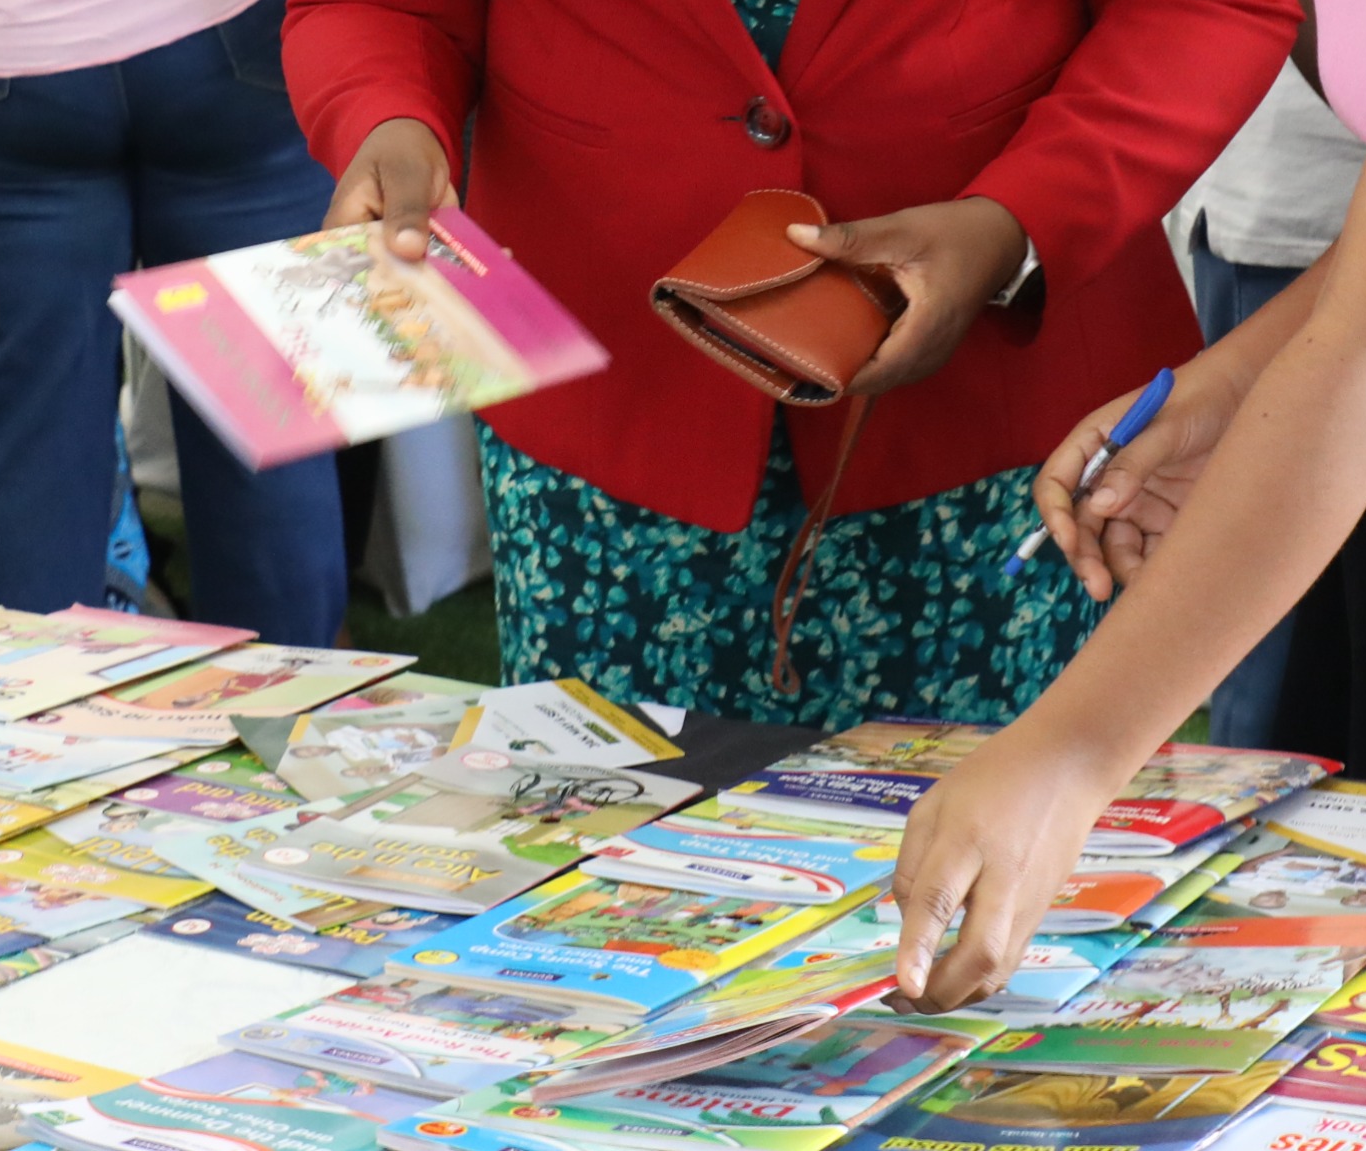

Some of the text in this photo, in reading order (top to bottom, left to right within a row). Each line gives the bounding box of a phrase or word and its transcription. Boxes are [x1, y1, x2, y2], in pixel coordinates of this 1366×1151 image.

[173, 781, 223, 799] and
[312, 842, 368, 863] the
[678, 838, 833, 872] The Net Trap
[754, 846, 812, 862] Other
[815, 854, 849, 865] and
[412, 856, 501, 882] Alice
[468, 943, 532, 963] Camp
[561, 948, 616, 964] Other
[619, 955, 653, 967] and
[608, 963, 651, 978] The
[303, 1013, 513, 1061] The Road Accident
[614, 1088, 799, 1119] Dolfine
[112, 1096, 235, 1140] Drummer
[230, 1111, 291, 1136] Other
[238, 1127, 282, 1145] the
[289, 1127, 334, 1144] and
